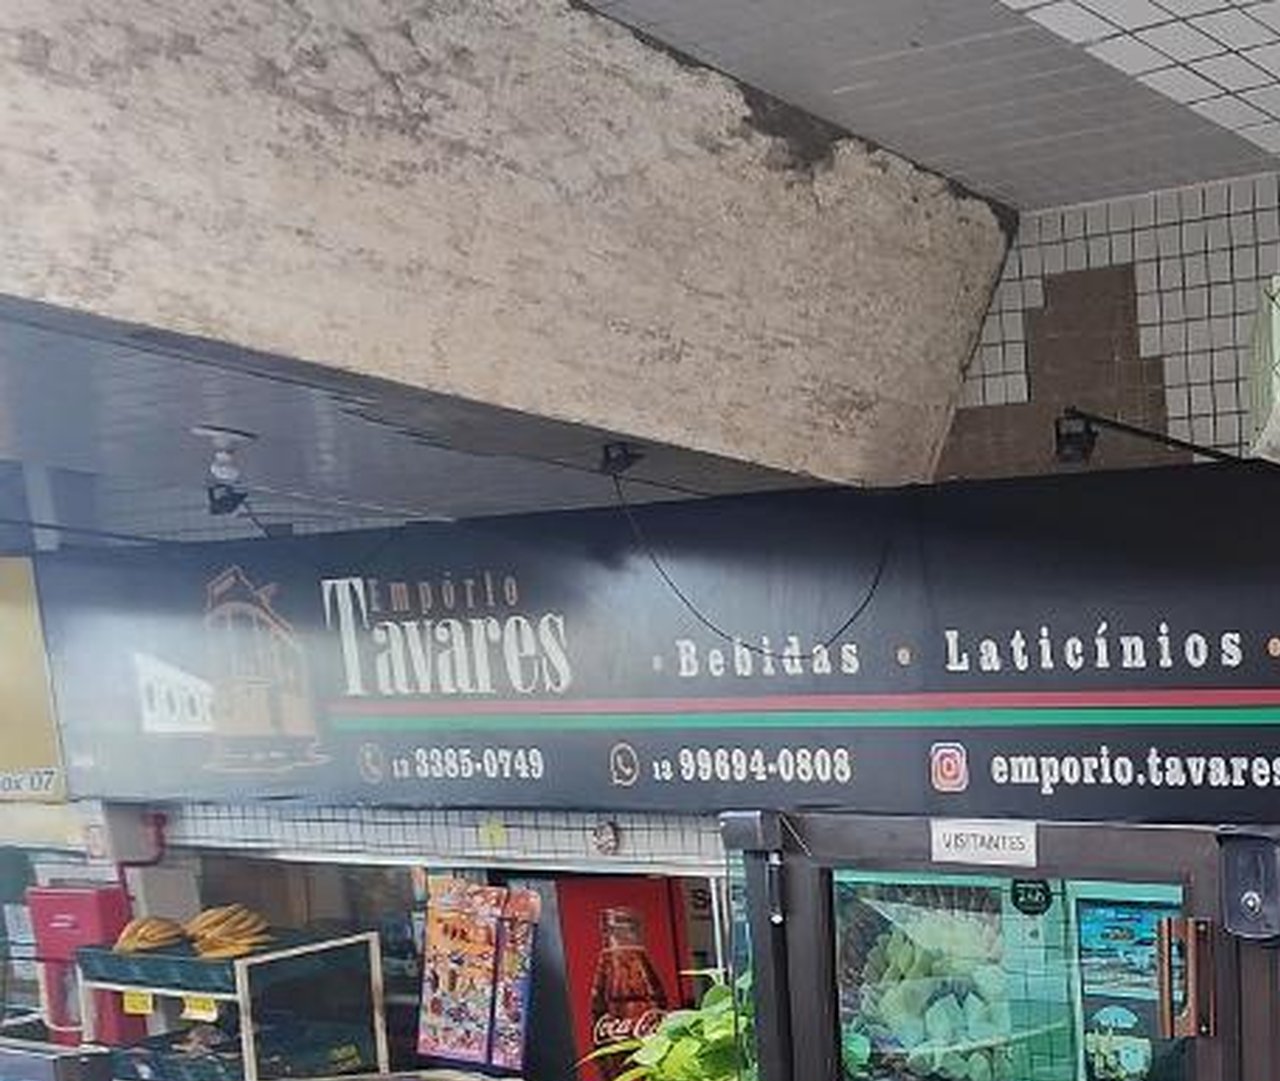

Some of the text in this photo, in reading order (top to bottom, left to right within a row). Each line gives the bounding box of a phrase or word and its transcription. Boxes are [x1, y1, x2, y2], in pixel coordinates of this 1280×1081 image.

[367, 571, 519, 614] Empório
[320, 576, 573, 696] Tavares
[675, 635, 861, 678] Bebidas
[943, 621, 1244, 672] Laticínios
[415, 747, 545, 779] 3385-0749
[678, 747, 851, 783] 99694-0808
[942, 831, 1027, 852] VISITANTES
